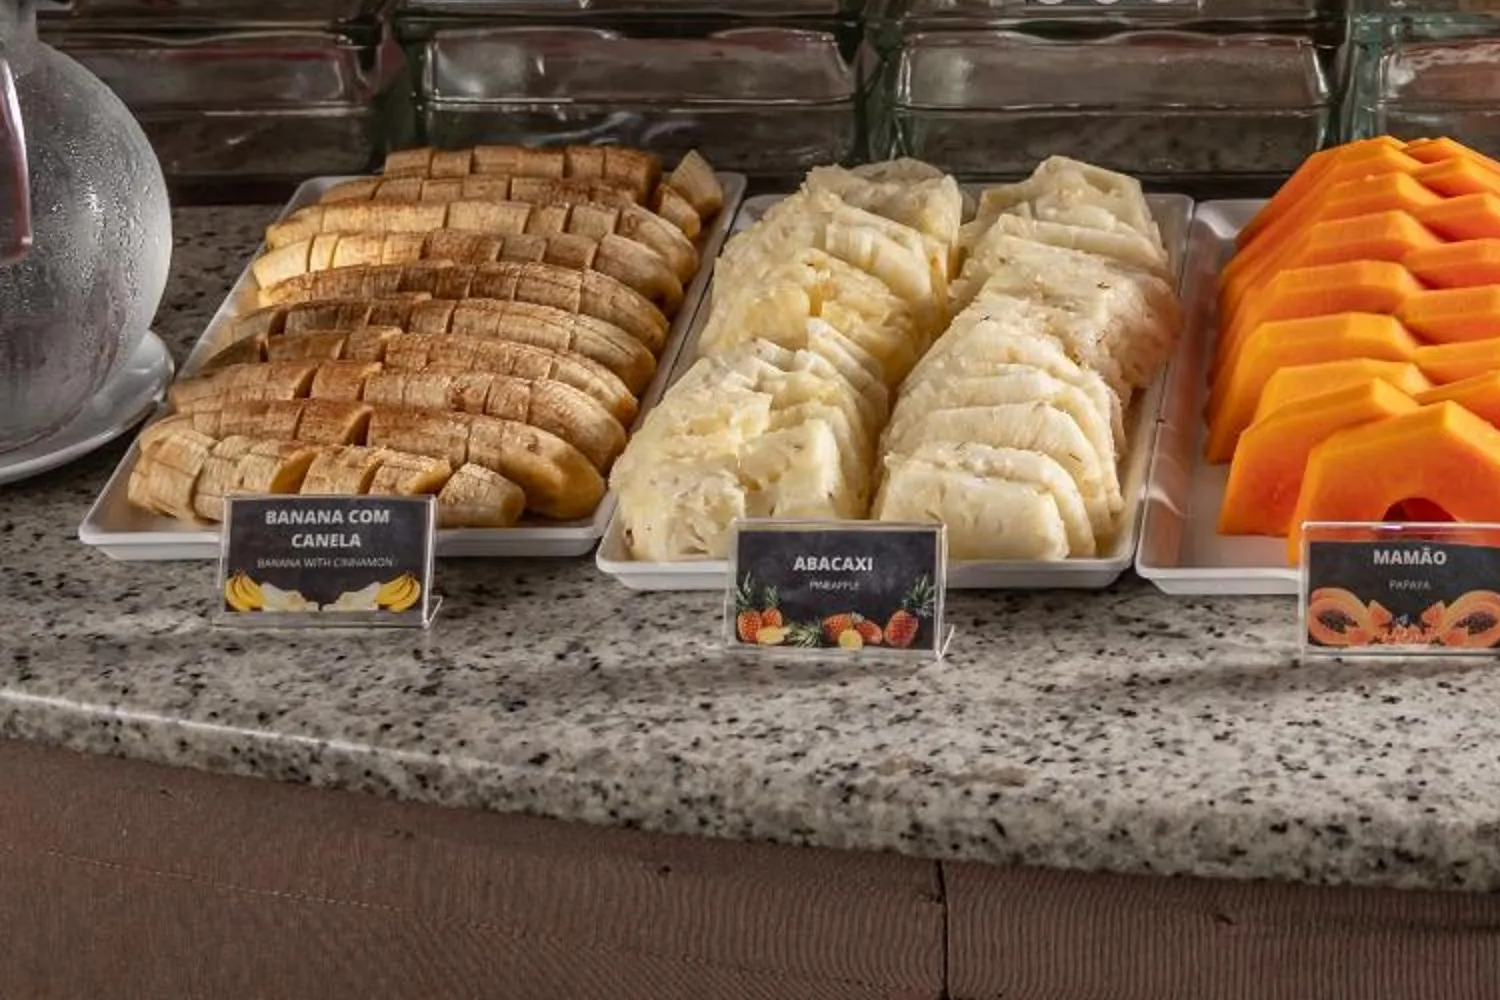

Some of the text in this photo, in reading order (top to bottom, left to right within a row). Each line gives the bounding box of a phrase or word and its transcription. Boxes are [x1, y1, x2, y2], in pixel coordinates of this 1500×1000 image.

[265, 509, 390, 525] BANANA COM
[291, 533, 362, 548] CANELA
[257, 557, 301, 569] BANANA
[303, 557, 330, 568] WITH
[1373, 546, 1447, 565] MAMÃO
[792, 556, 873, 572] ABACAXI
[1388, 579, 1431, 590] PAPAYA
